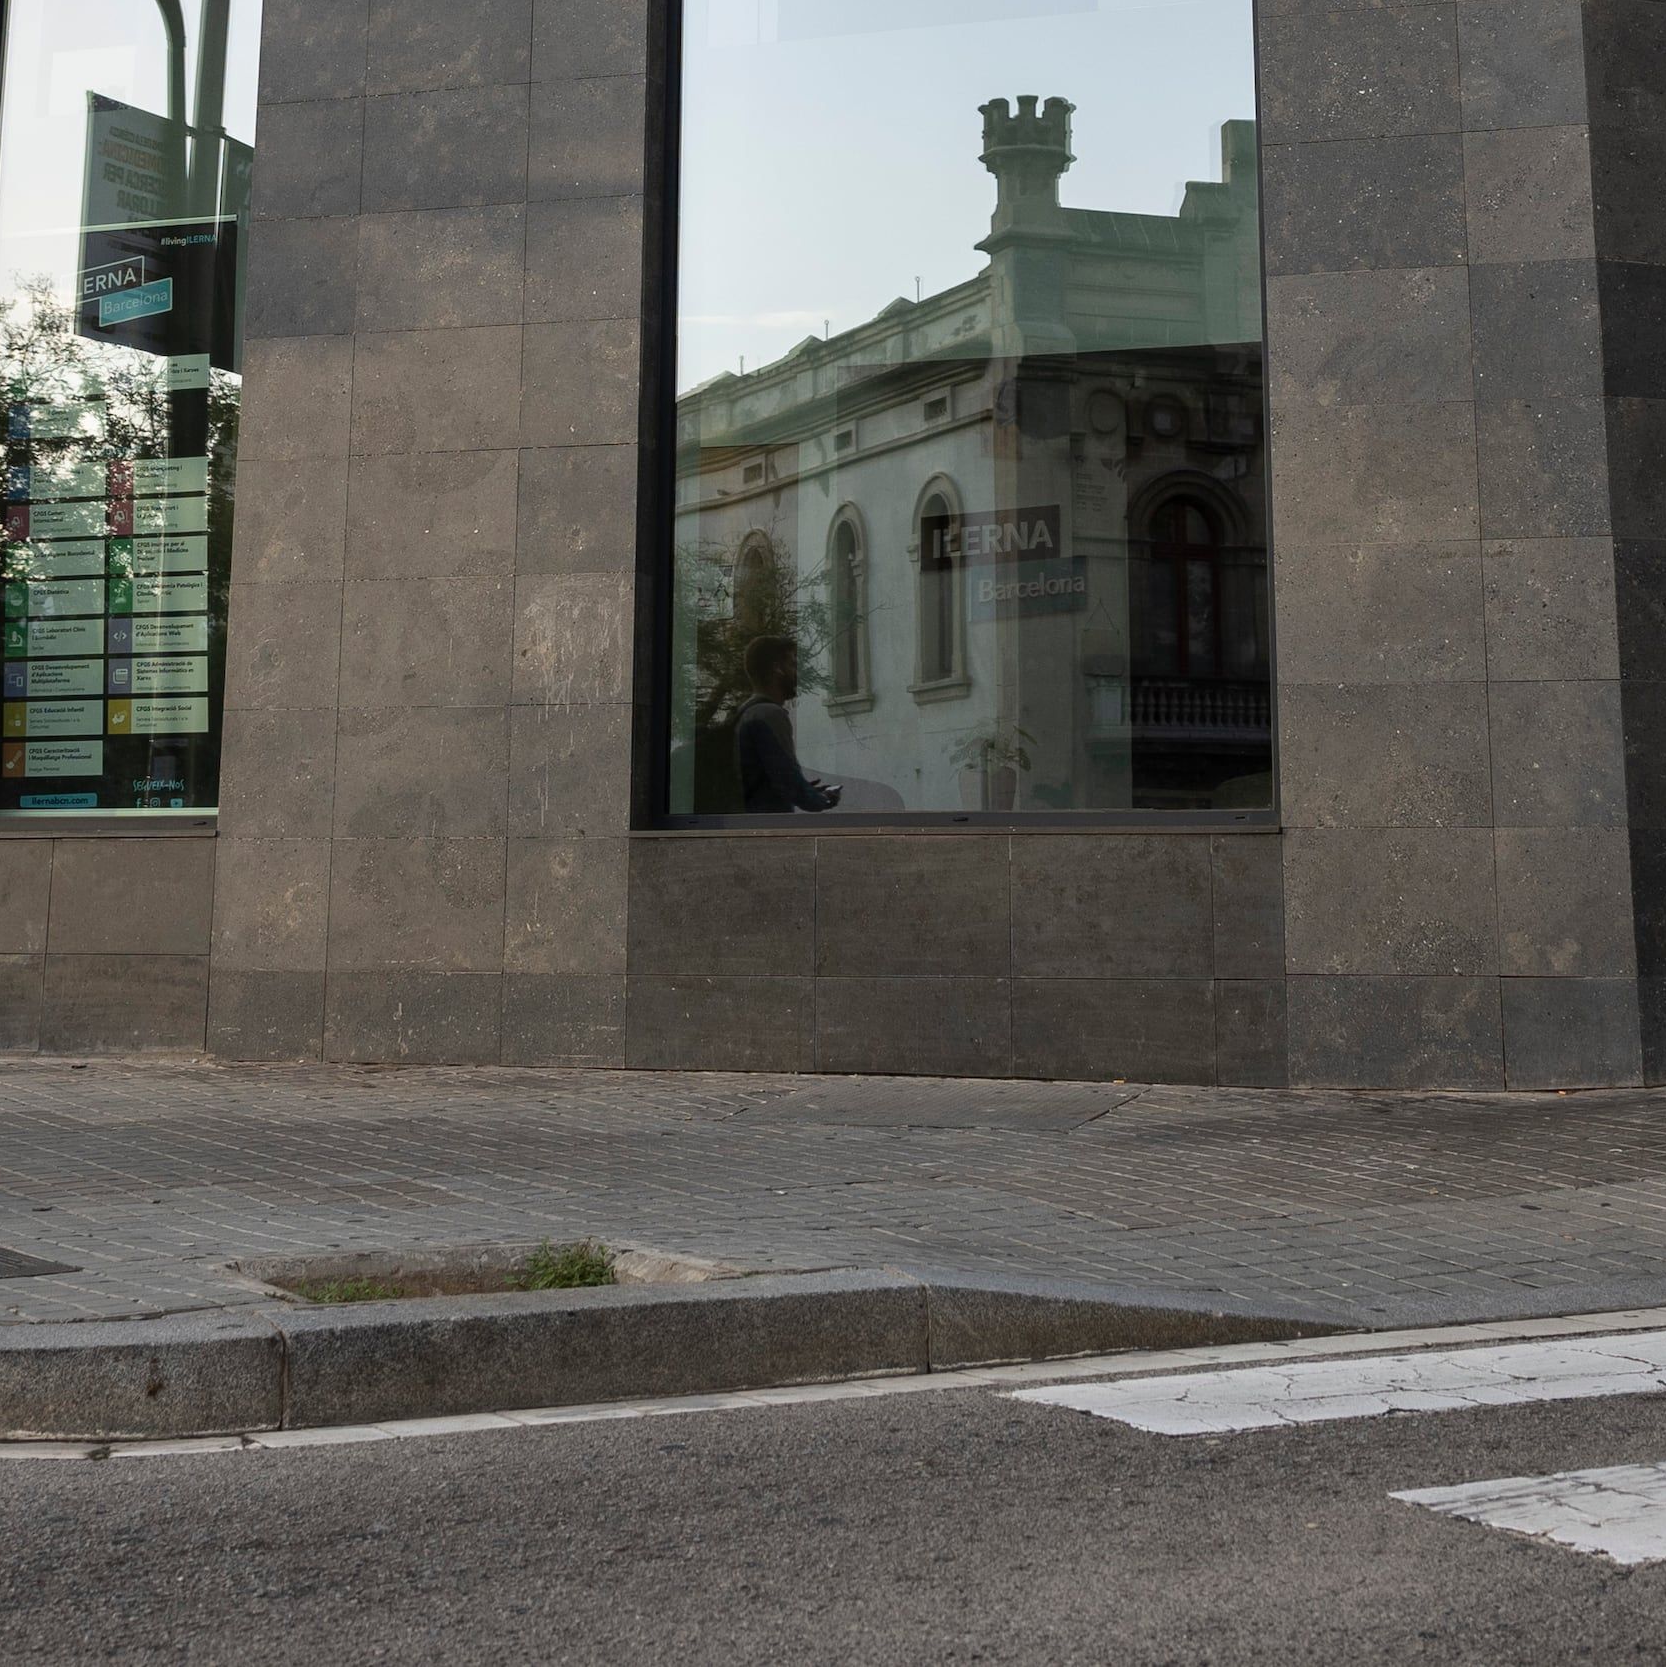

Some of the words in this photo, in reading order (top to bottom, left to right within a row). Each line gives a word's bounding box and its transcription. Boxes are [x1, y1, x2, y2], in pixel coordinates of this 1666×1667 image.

[104, 291, 168, 315] Barcelona
[933, 520, 1053, 558] ILERNA
[978, 573, 1085, 602] Barcelona
[133, 780, 184, 792] SEGUEIX-NOS
[31, 797, 88, 805] ilernabcn.com
